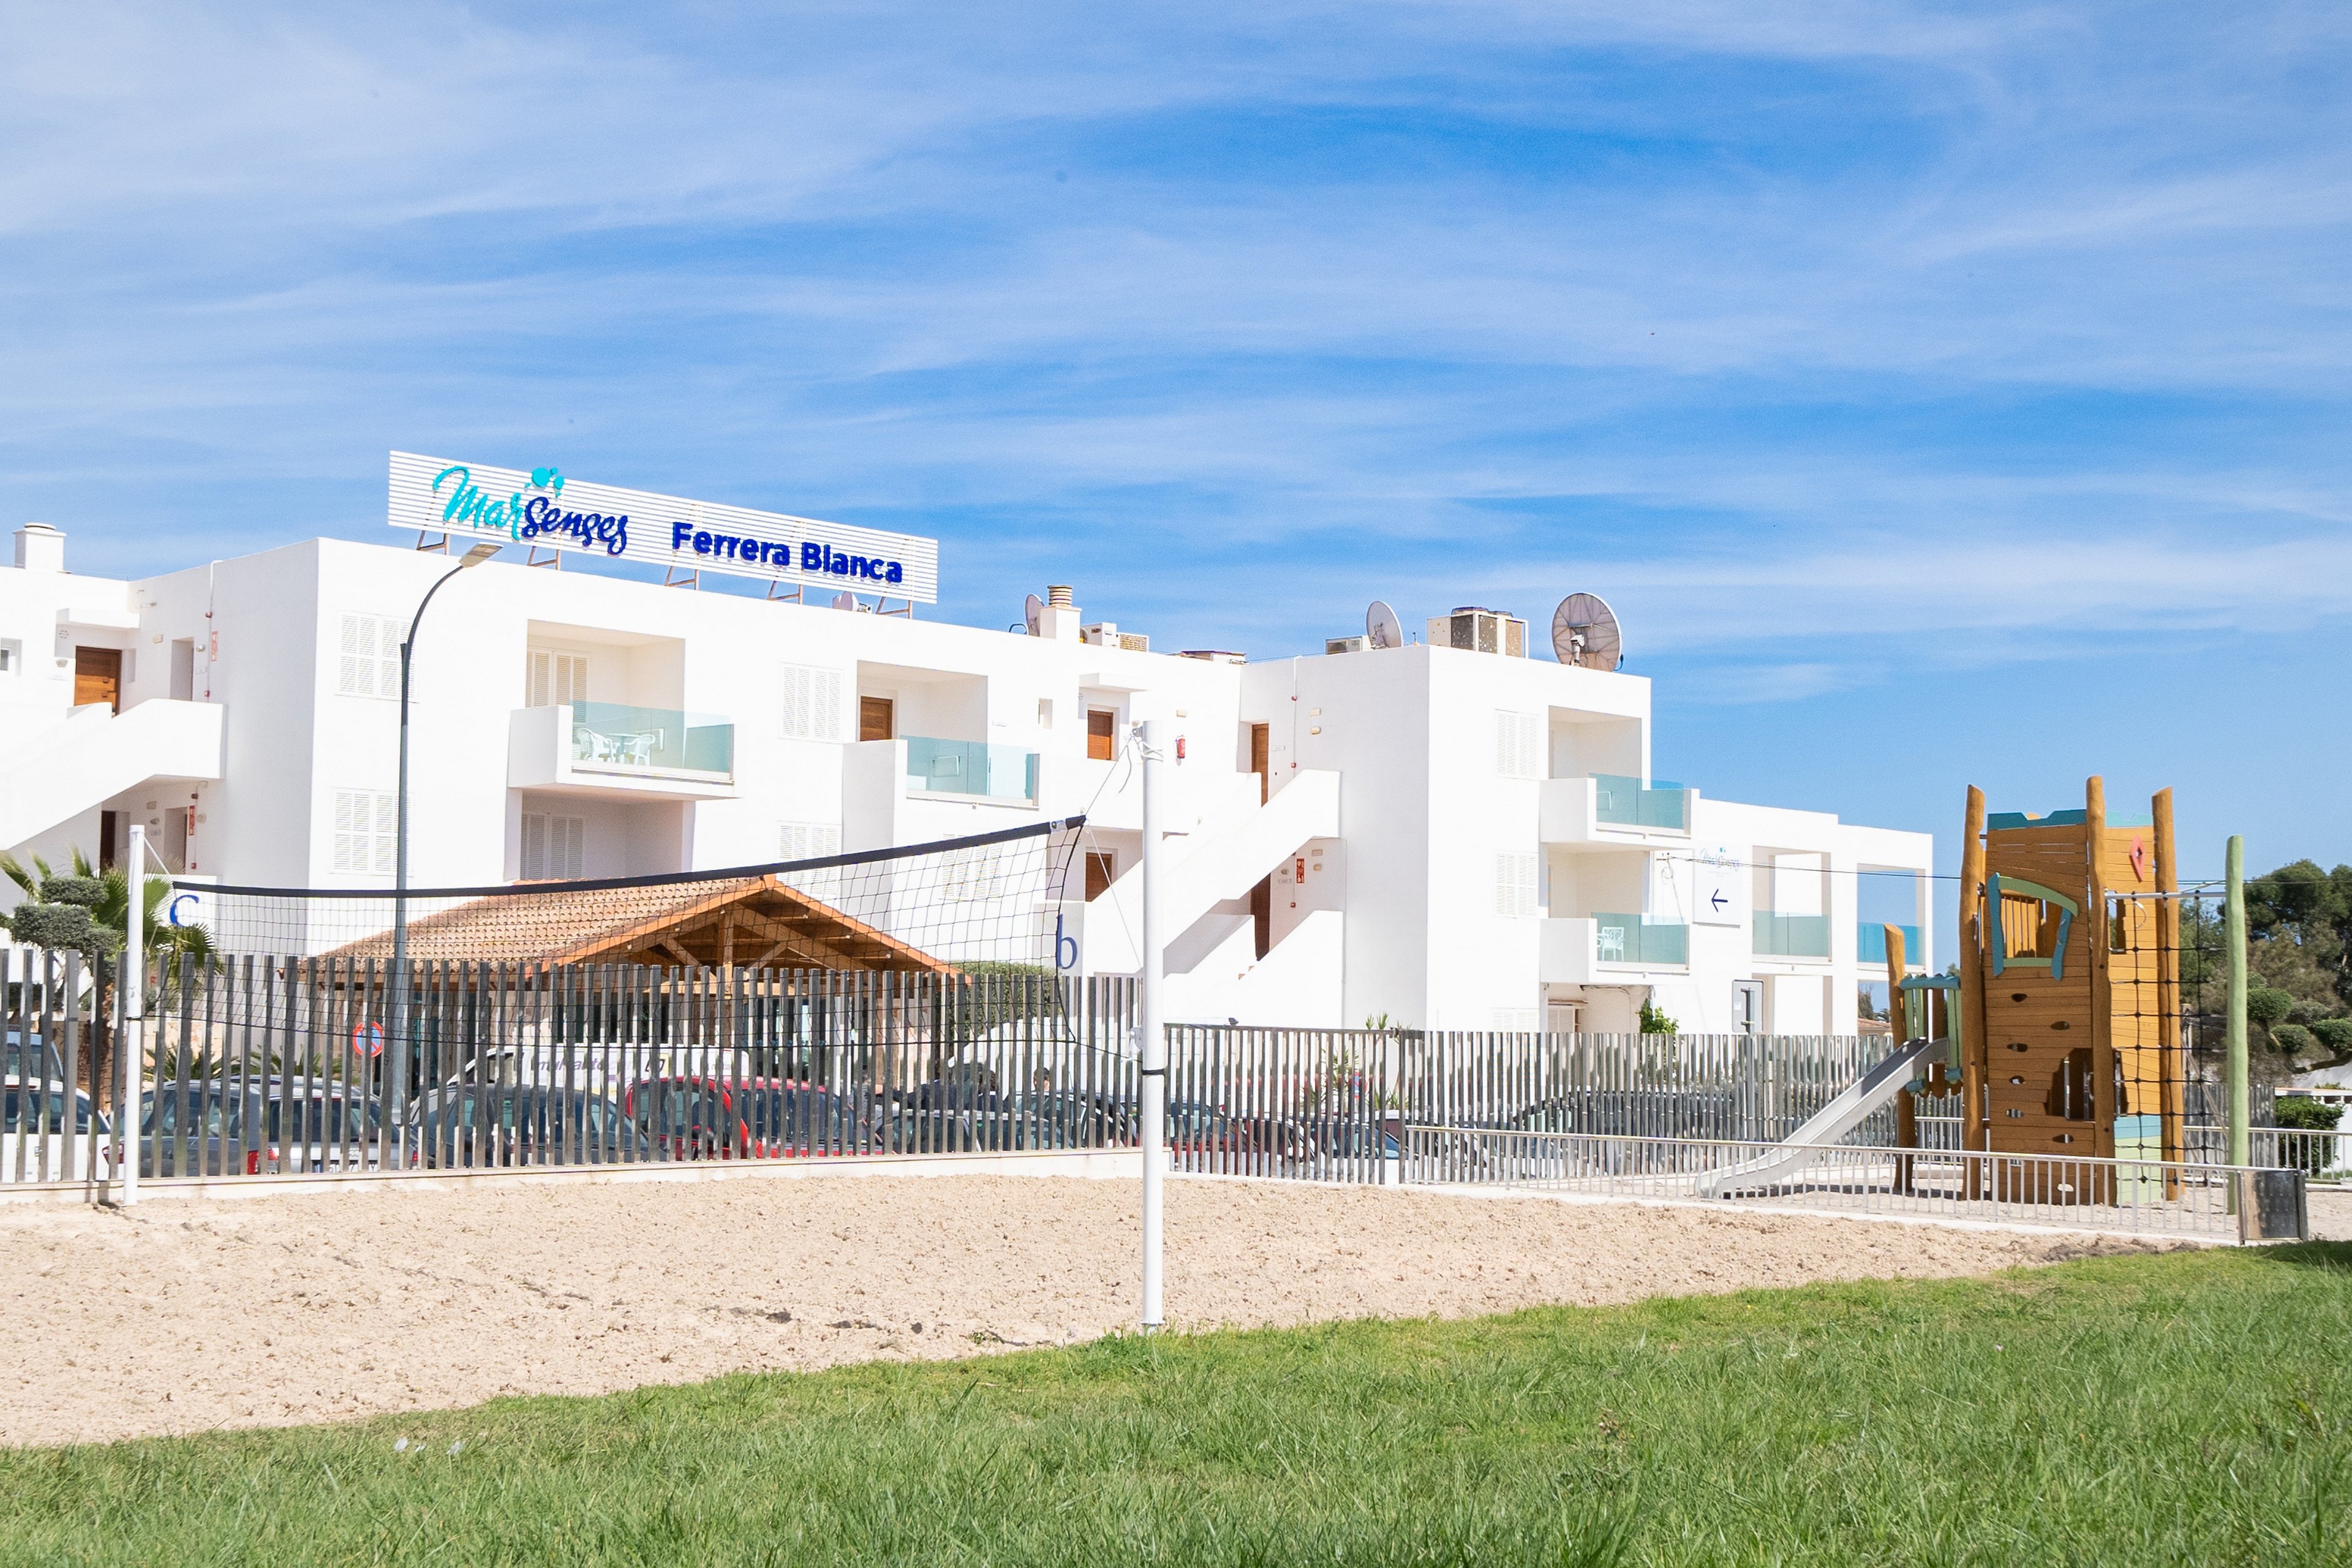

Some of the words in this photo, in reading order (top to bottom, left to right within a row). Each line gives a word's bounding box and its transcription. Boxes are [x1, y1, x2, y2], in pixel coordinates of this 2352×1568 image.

[673, 522, 790, 566] Ferrera
[801, 542, 902, 582] Blanca
[1057, 913, 1077, 970] b
